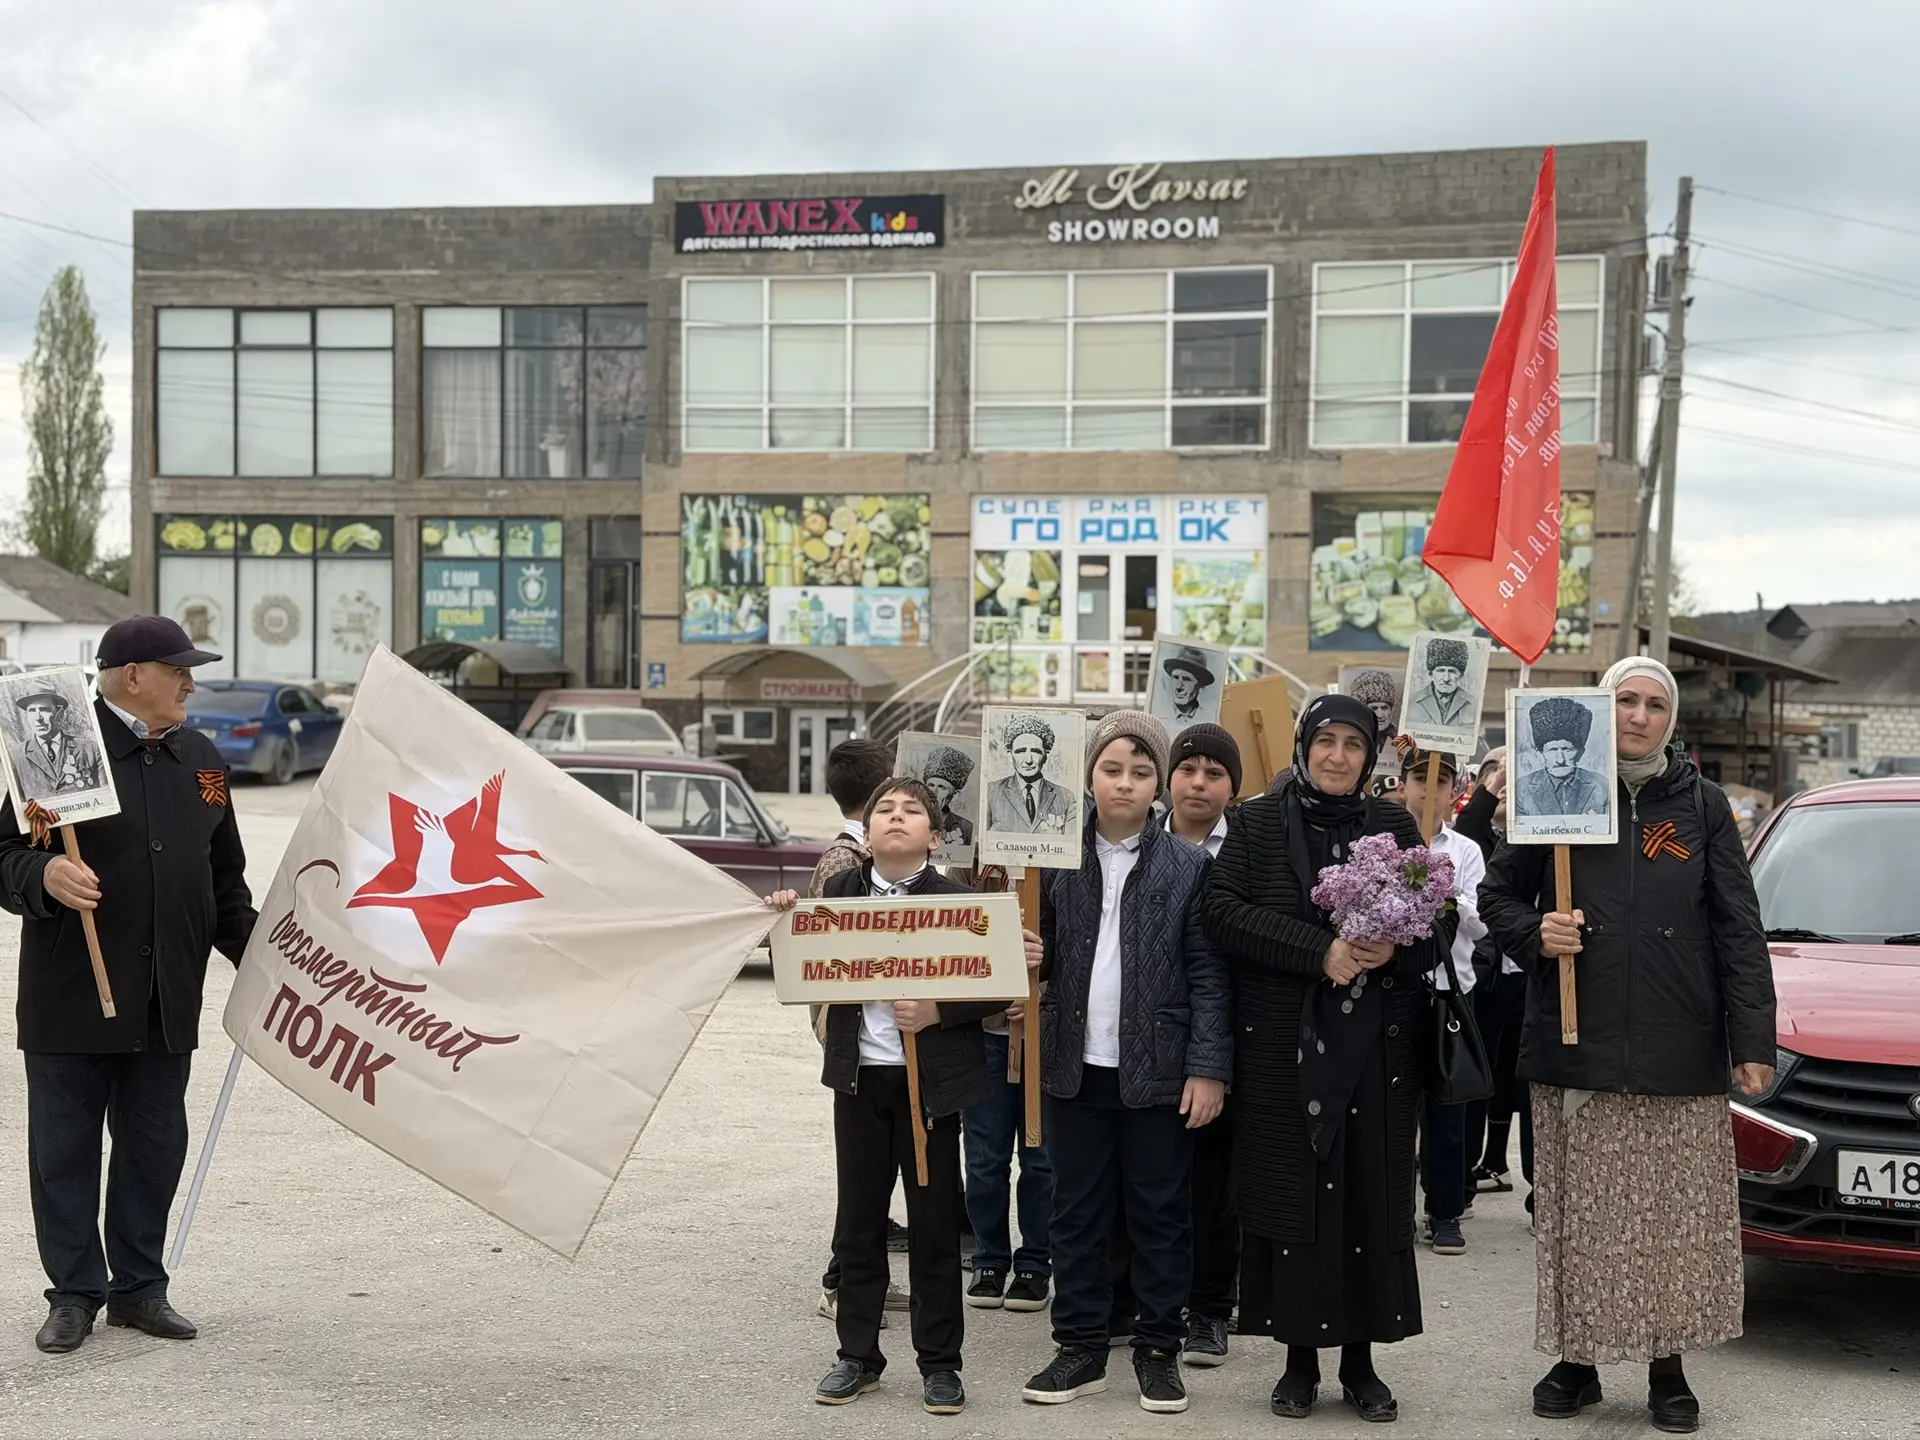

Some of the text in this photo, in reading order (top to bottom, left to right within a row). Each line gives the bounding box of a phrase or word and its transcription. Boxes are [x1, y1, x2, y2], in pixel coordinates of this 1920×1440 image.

[1014, 161, 1248, 211] Al Kavsar
[700, 199, 863, 236] WANEX
[1048, 216, 1220, 243] SHOWROOM
[996, 841, 1066, 854] Саламов М-ш.
[793, 906, 981, 933] Вы ПОБЕДИЛИ!
[803, 955, 988, 981] Мы НЕ ЗАБЫЛИ!
[262, 982, 397, 1107] ПОЛК
[1861, 1198, 1882, 1206] LADA
